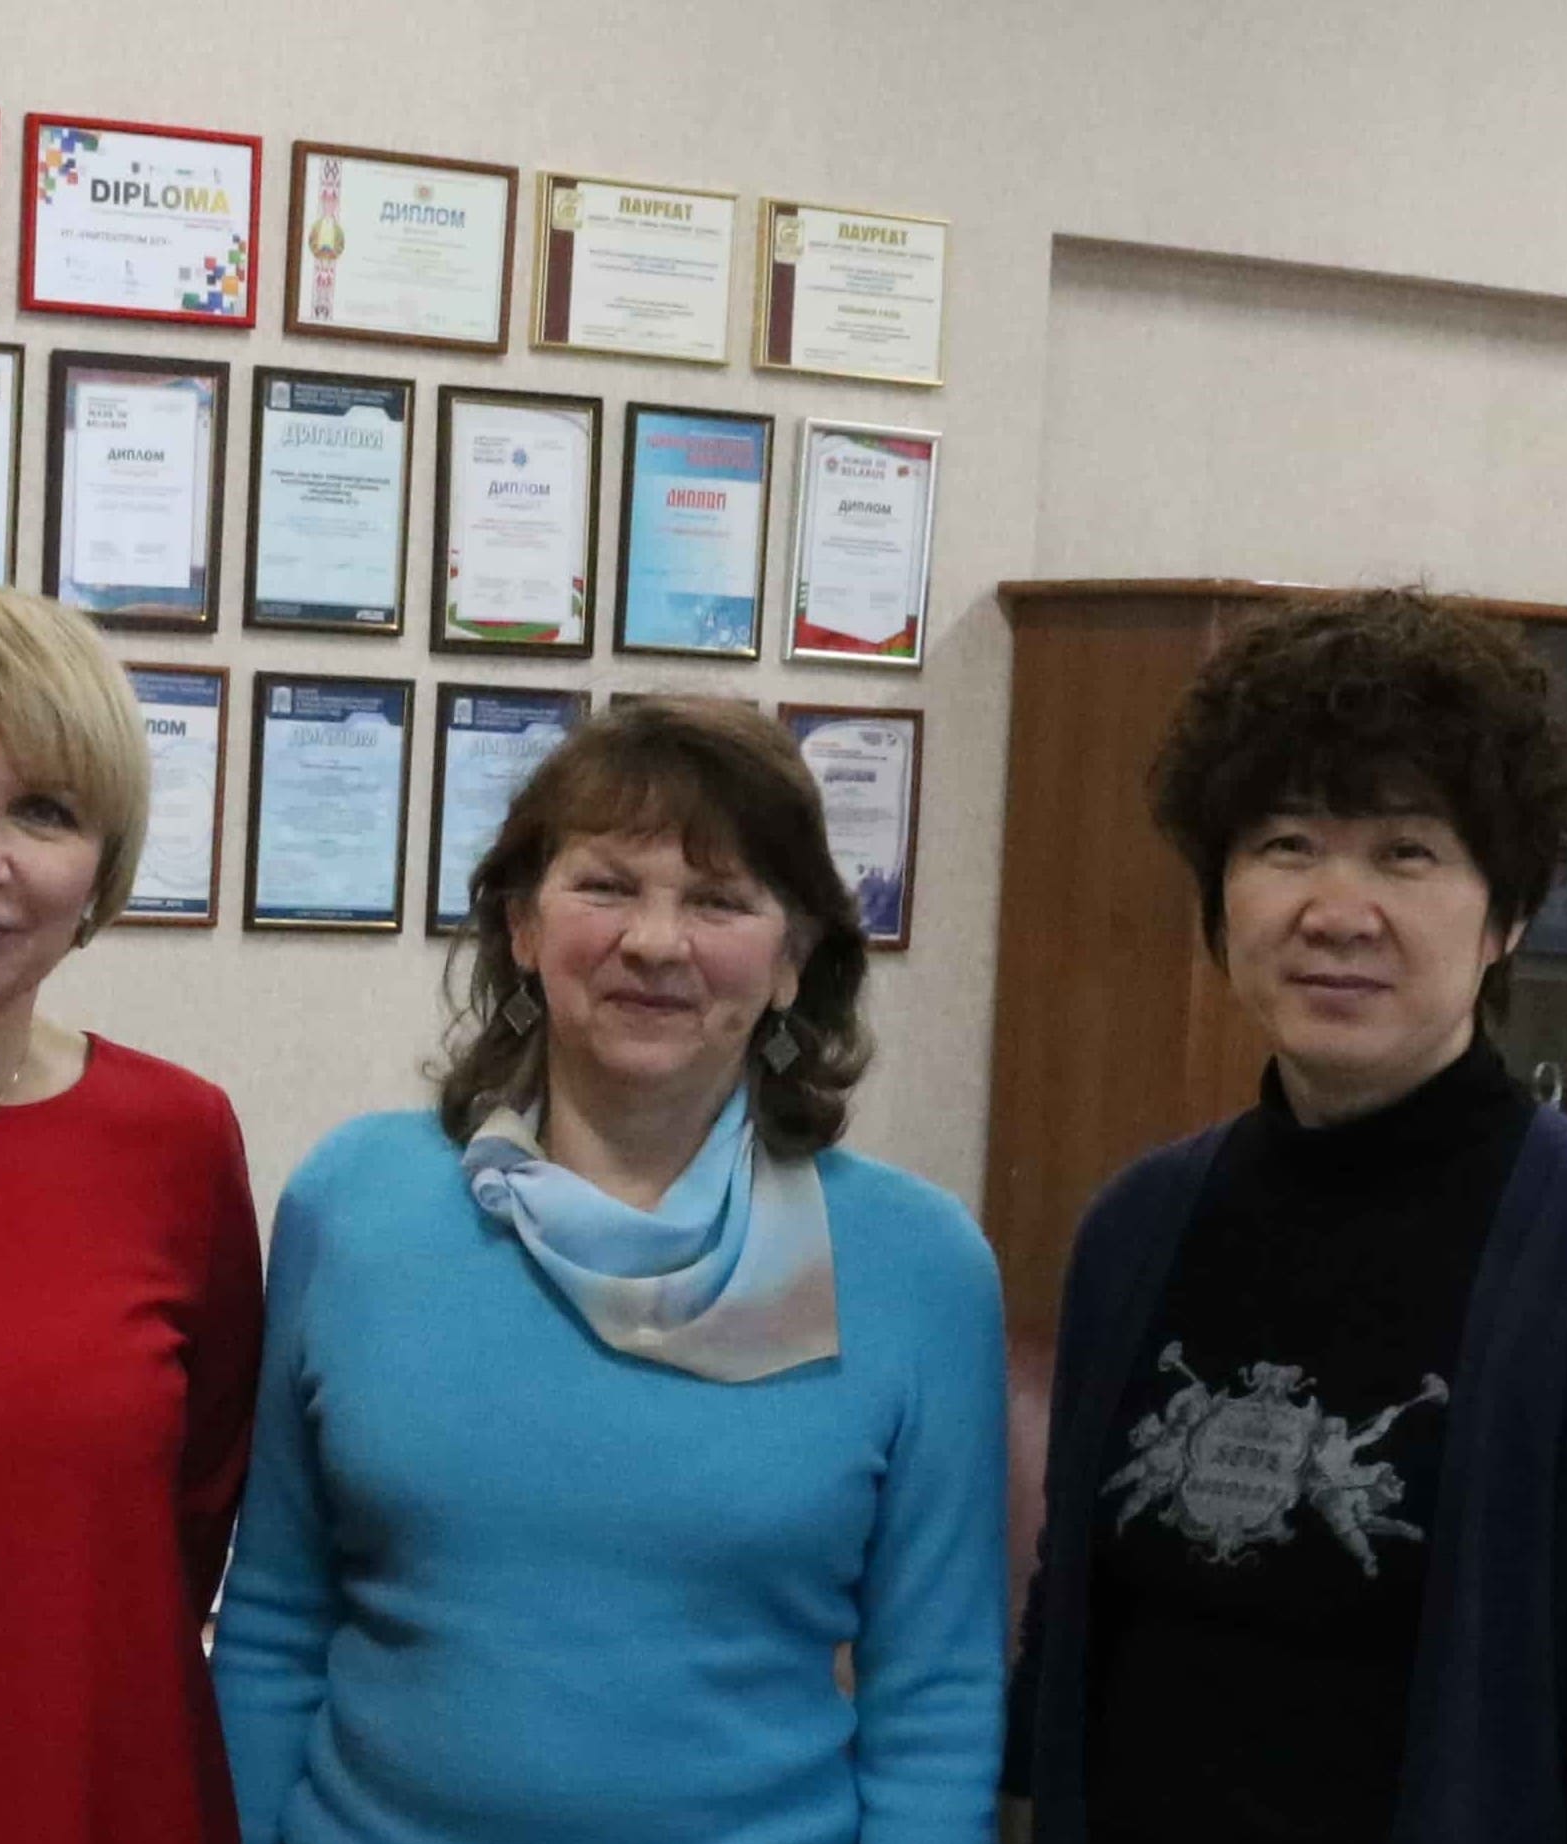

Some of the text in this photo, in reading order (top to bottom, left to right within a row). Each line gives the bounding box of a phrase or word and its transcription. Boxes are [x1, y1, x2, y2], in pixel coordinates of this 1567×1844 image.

[90, 178, 232, 214] DIPLOMA
[618, 195, 694, 221] ЛАУРЕАТ
[379, 200, 466, 229] ДИПЛОМ
[837, 222, 909, 246] ЛАУРЕАТ
[281, 420, 384, 450] ДИПЛОМ
[107, 447, 165, 462] ДИПЛОМ
[487, 480, 551, 498] ДИПЛОМ
[838, 498, 892, 516] ДИПЛОМ
